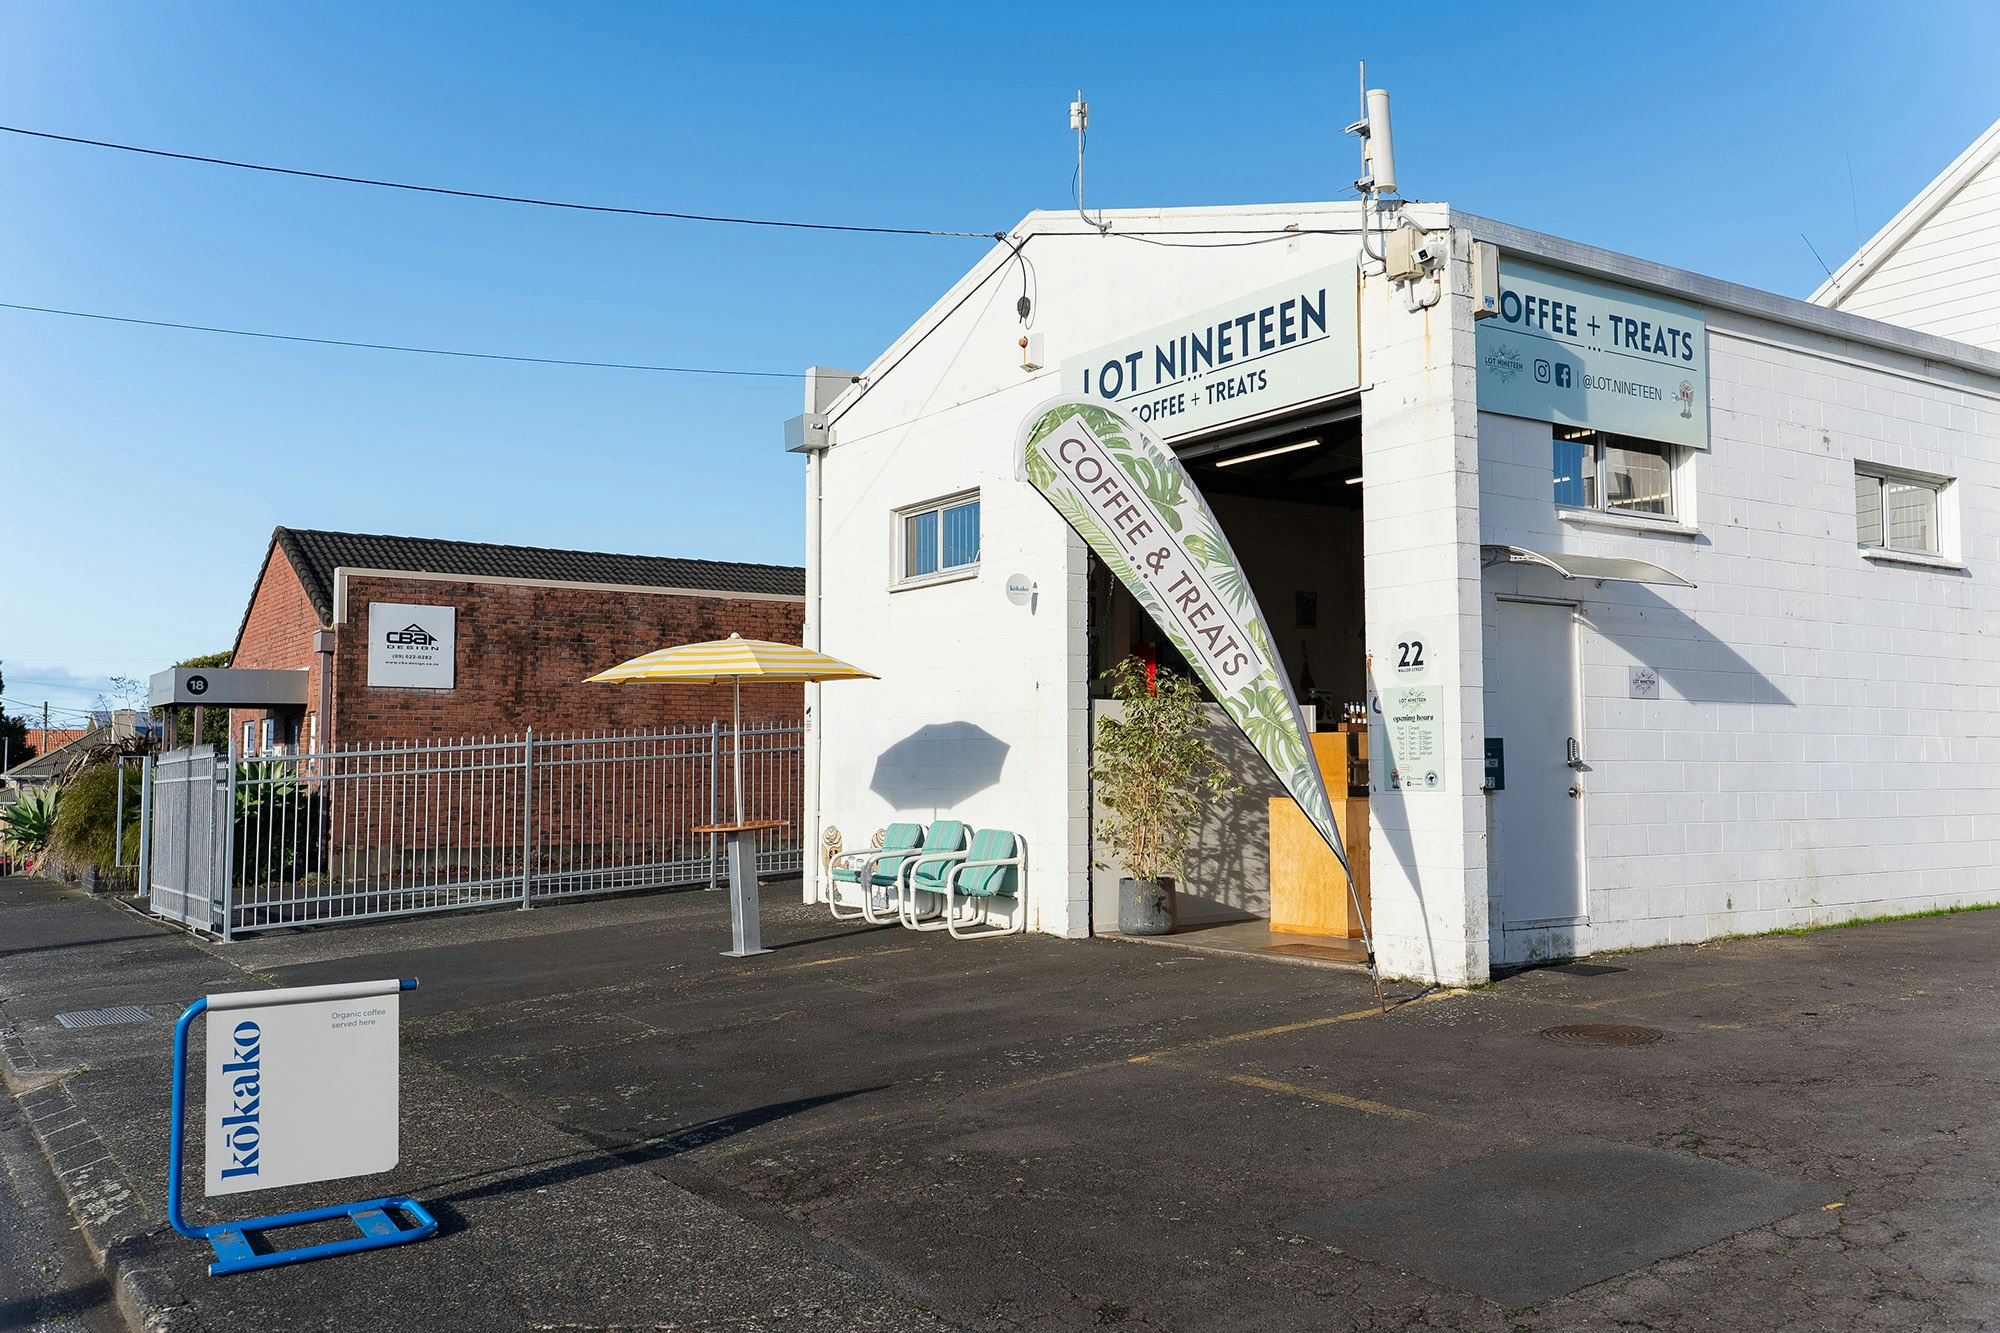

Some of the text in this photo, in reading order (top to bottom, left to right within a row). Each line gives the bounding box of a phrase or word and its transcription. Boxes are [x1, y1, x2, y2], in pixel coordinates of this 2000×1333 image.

[1156, 288, 1327, 385] NINETEEN
[1491, 290, 1578, 338] OFFEE
[1608, 314, 1694, 362] TREATS
[1484, 356, 1524, 370] LOT NINETEEN
[1205, 369, 1268, 405] TREATS
[1582, 374, 1663, 402] @LOT.NINETEEN
[1058, 438, 1249, 676] COFFEE & TREATS
[1397, 640, 1424, 668] 22
[190, 680, 204, 691] 18
[1393, 714, 1416, 723] opening
[331, 1008, 387, 1020] Organic coffee
[331, 1020, 358, 1029] served
[221, 1020, 262, 1181] kōkako
